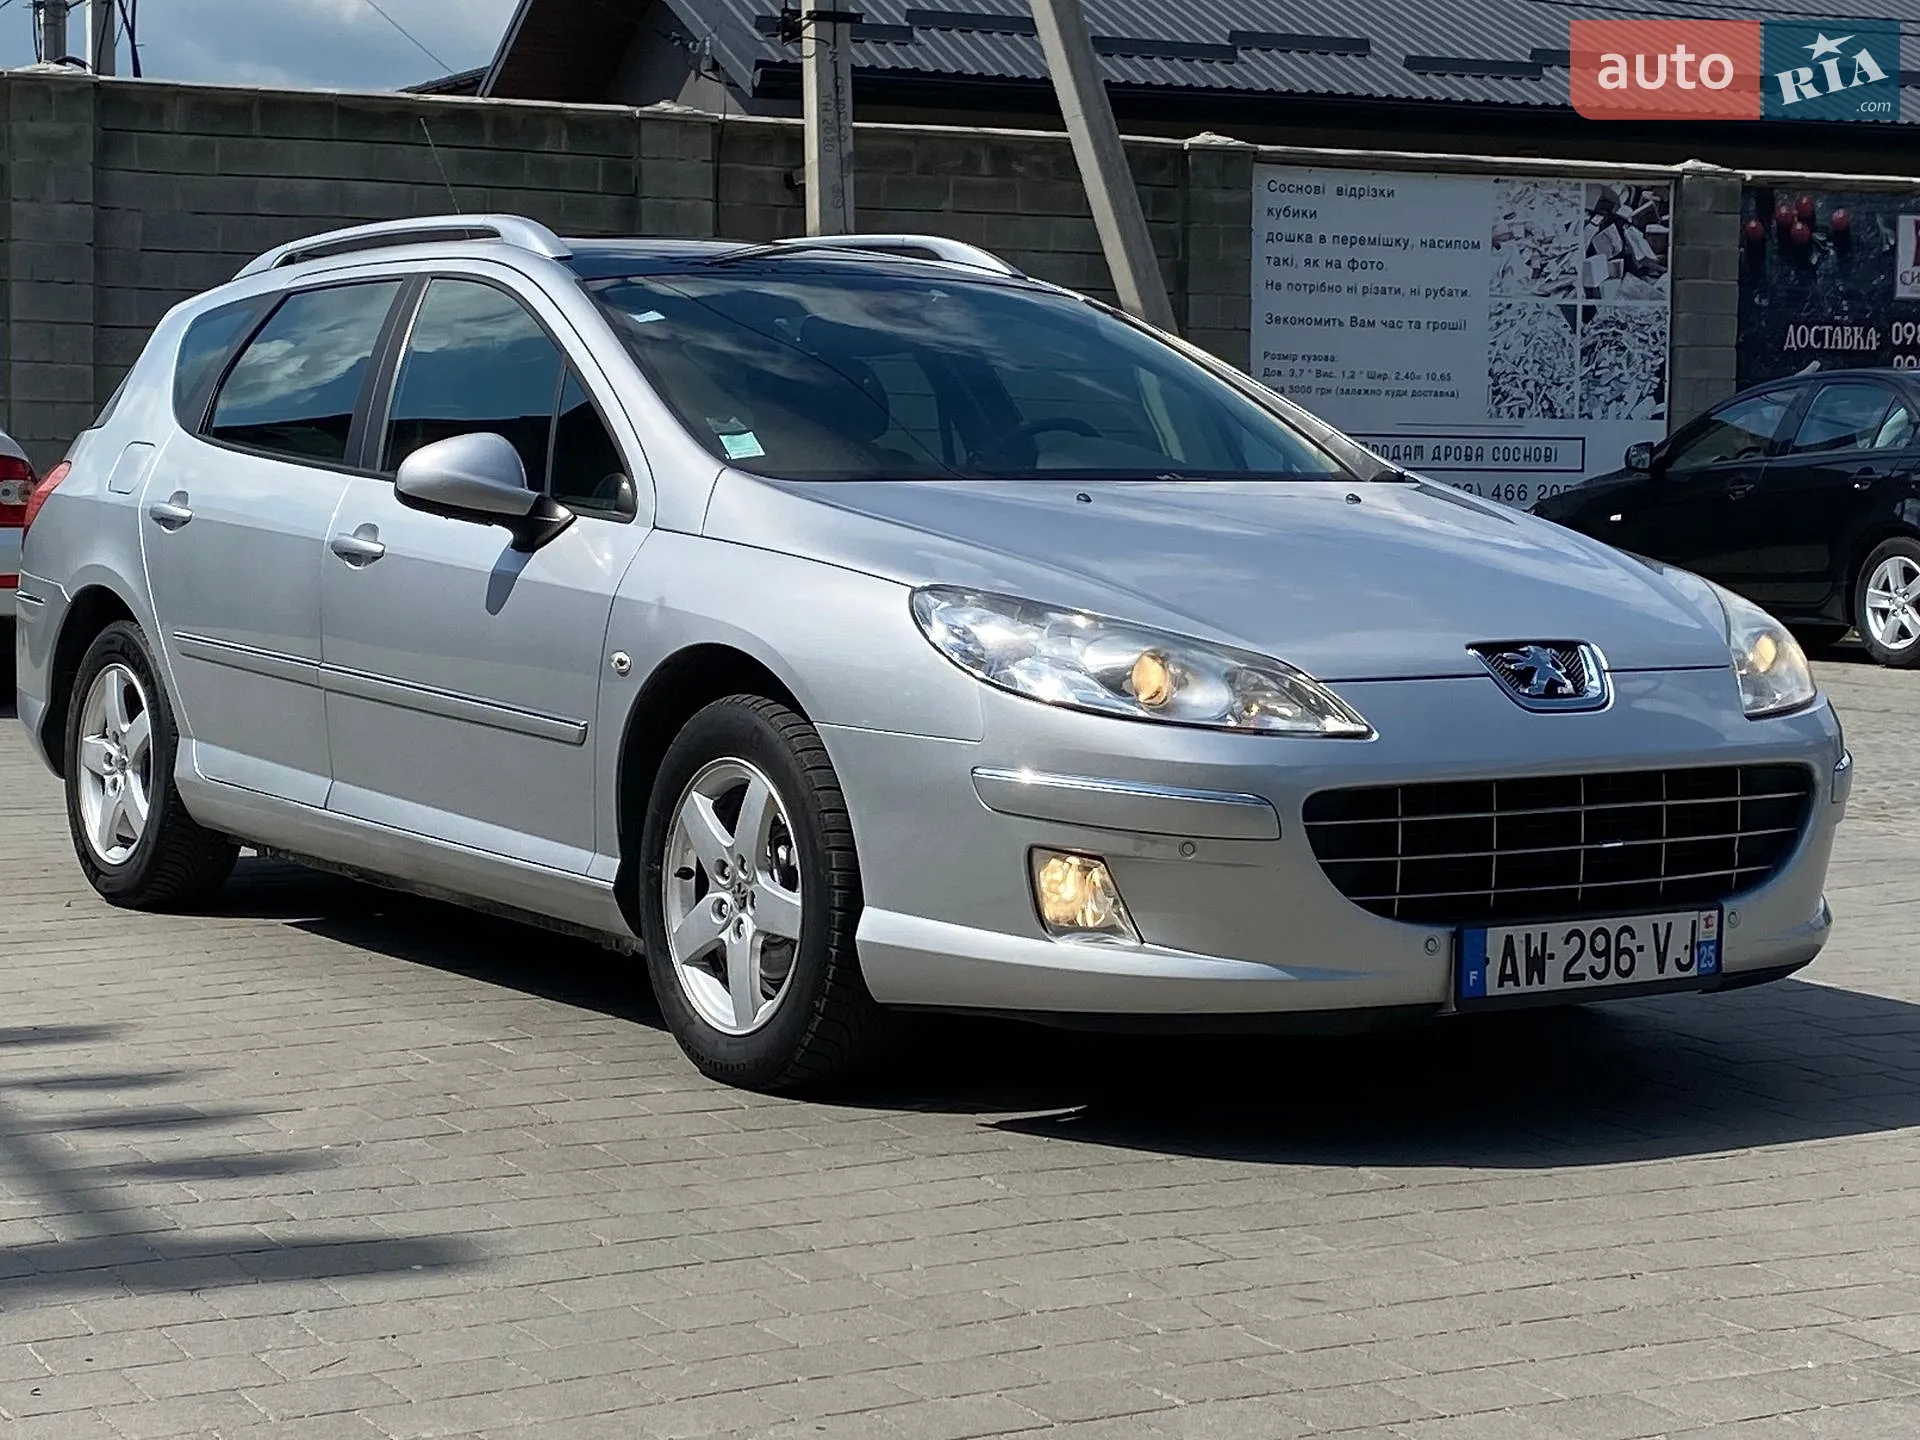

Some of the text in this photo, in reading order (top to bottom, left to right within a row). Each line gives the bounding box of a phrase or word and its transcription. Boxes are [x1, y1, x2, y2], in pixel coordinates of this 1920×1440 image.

[1267, 179, 1395, 200] Соснові відрізки
[1266, 203, 1318, 220] кубики
[1265, 230, 1481, 251] дошка в перемішку, насипом
[1265, 254, 1298, 270] такі,
[1303, 257, 1320, 269] як
[1325, 258, 1342, 270] на
[1265, 280, 1472, 300] Не потрібно ні різати, ні рубати.
[1265, 312, 1467, 333] Зекономить Вам час та гроші!
[1783, 323, 1881, 351] ДОСТАВКА:
[1263, 351, 1339, 365] Розмір кузова:
[1431, 443, 1484, 462] ДРОВА
[1492, 444, 1559, 463] СОСНОВІ
[1491, 483, 1528, 501] 466
[1497, 919, 1697, 989] AW-296-VJ
[1699, 944, 1716, 969] 25
[1469, 970, 1478, 987] F
